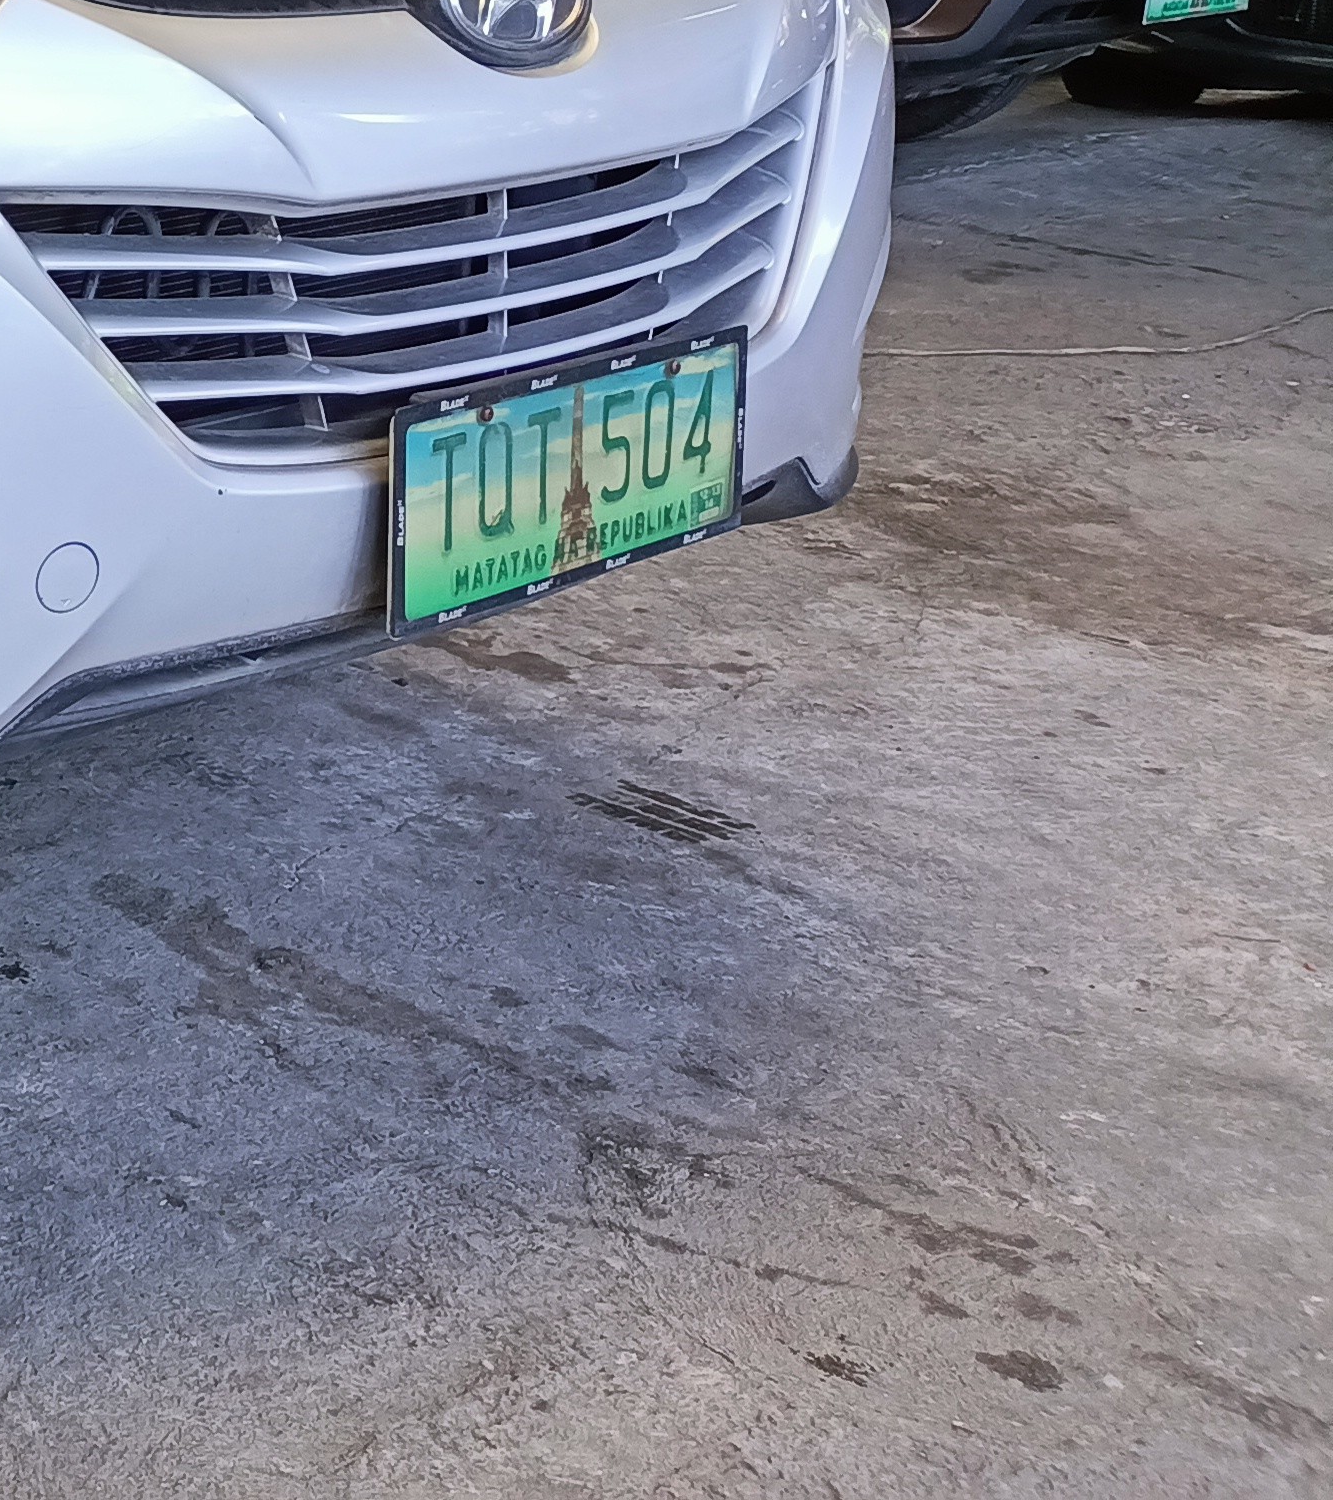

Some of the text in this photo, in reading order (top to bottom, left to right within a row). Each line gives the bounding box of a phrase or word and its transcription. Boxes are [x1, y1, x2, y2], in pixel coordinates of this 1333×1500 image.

[432, 369, 715, 553] TQT 504
[454, 543, 547, 597] MATATAG
[585, 499, 688, 553] REPUBLIKA
